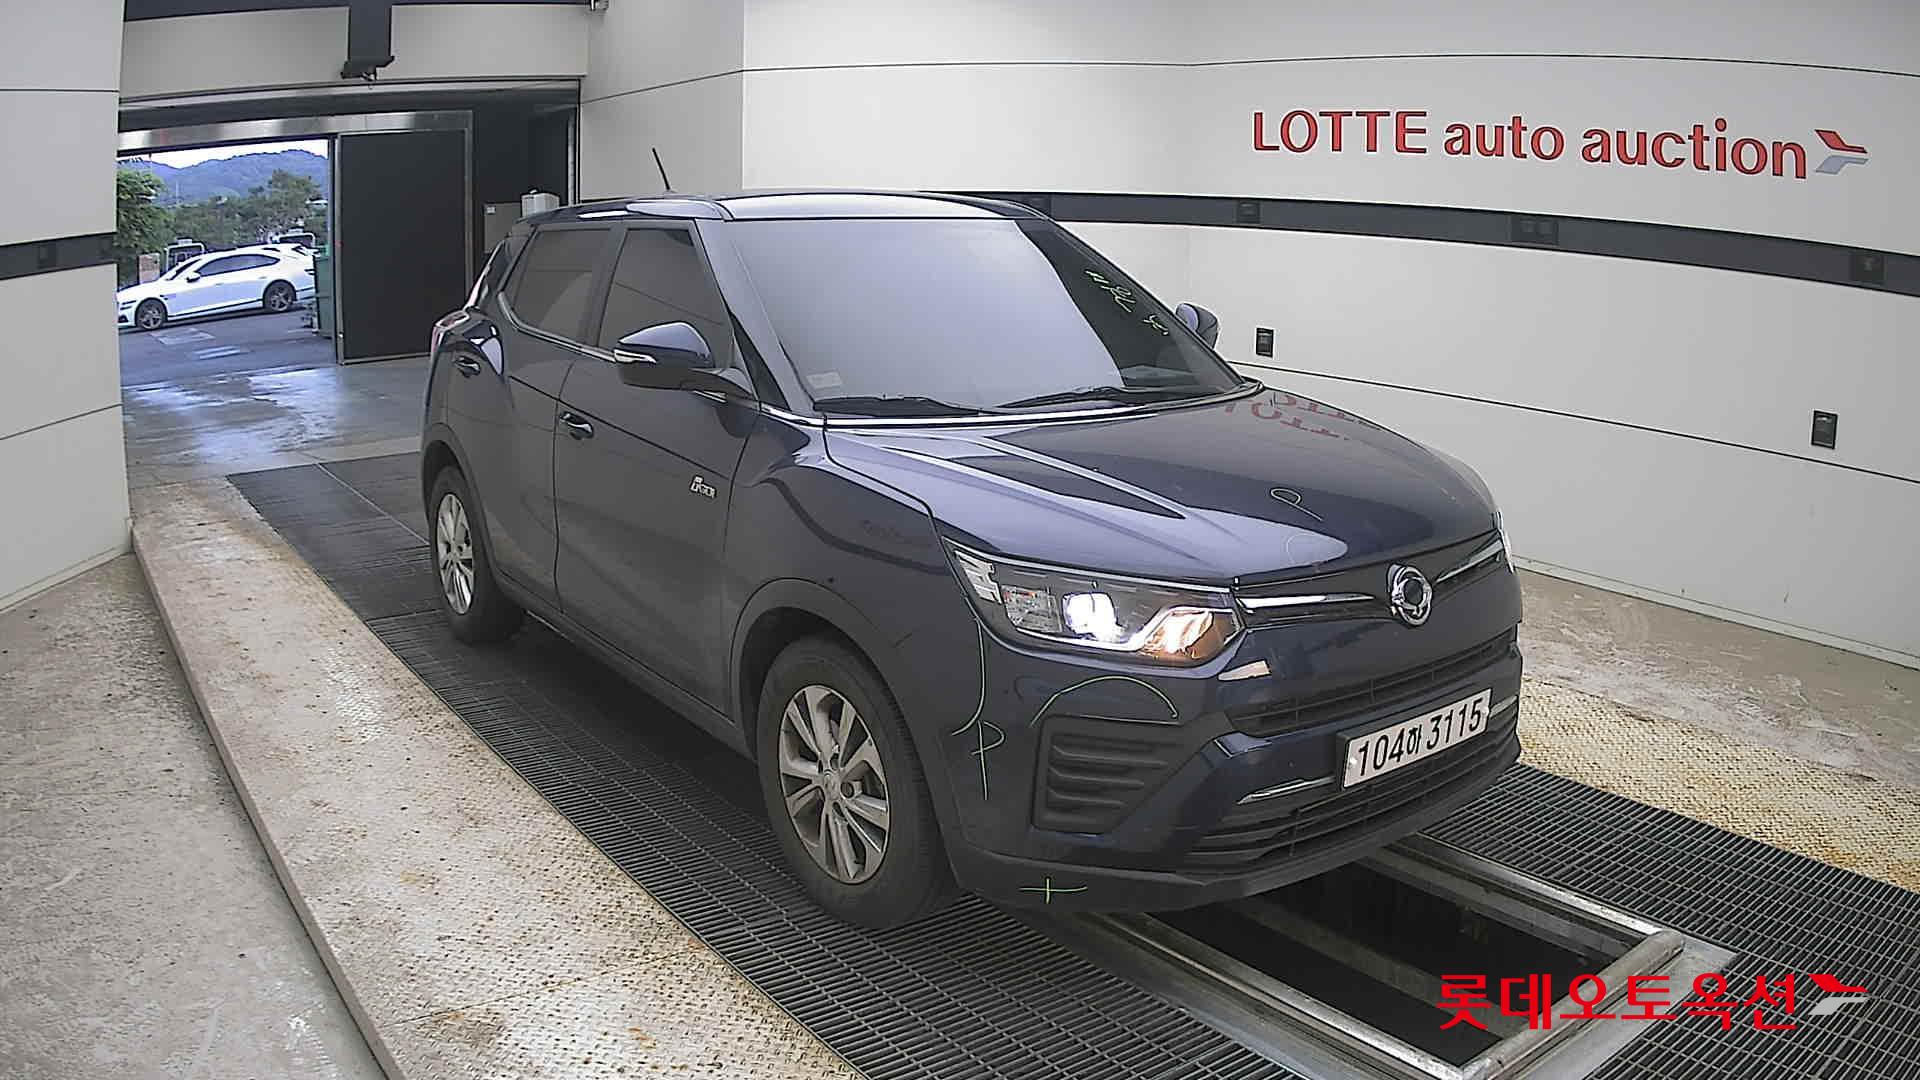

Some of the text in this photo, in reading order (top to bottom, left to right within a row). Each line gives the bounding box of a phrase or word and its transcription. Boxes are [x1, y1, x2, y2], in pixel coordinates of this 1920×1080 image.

[1252, 110, 1808, 180] LOTTE auto auction
[1426, 697, 1483, 750] 3115
